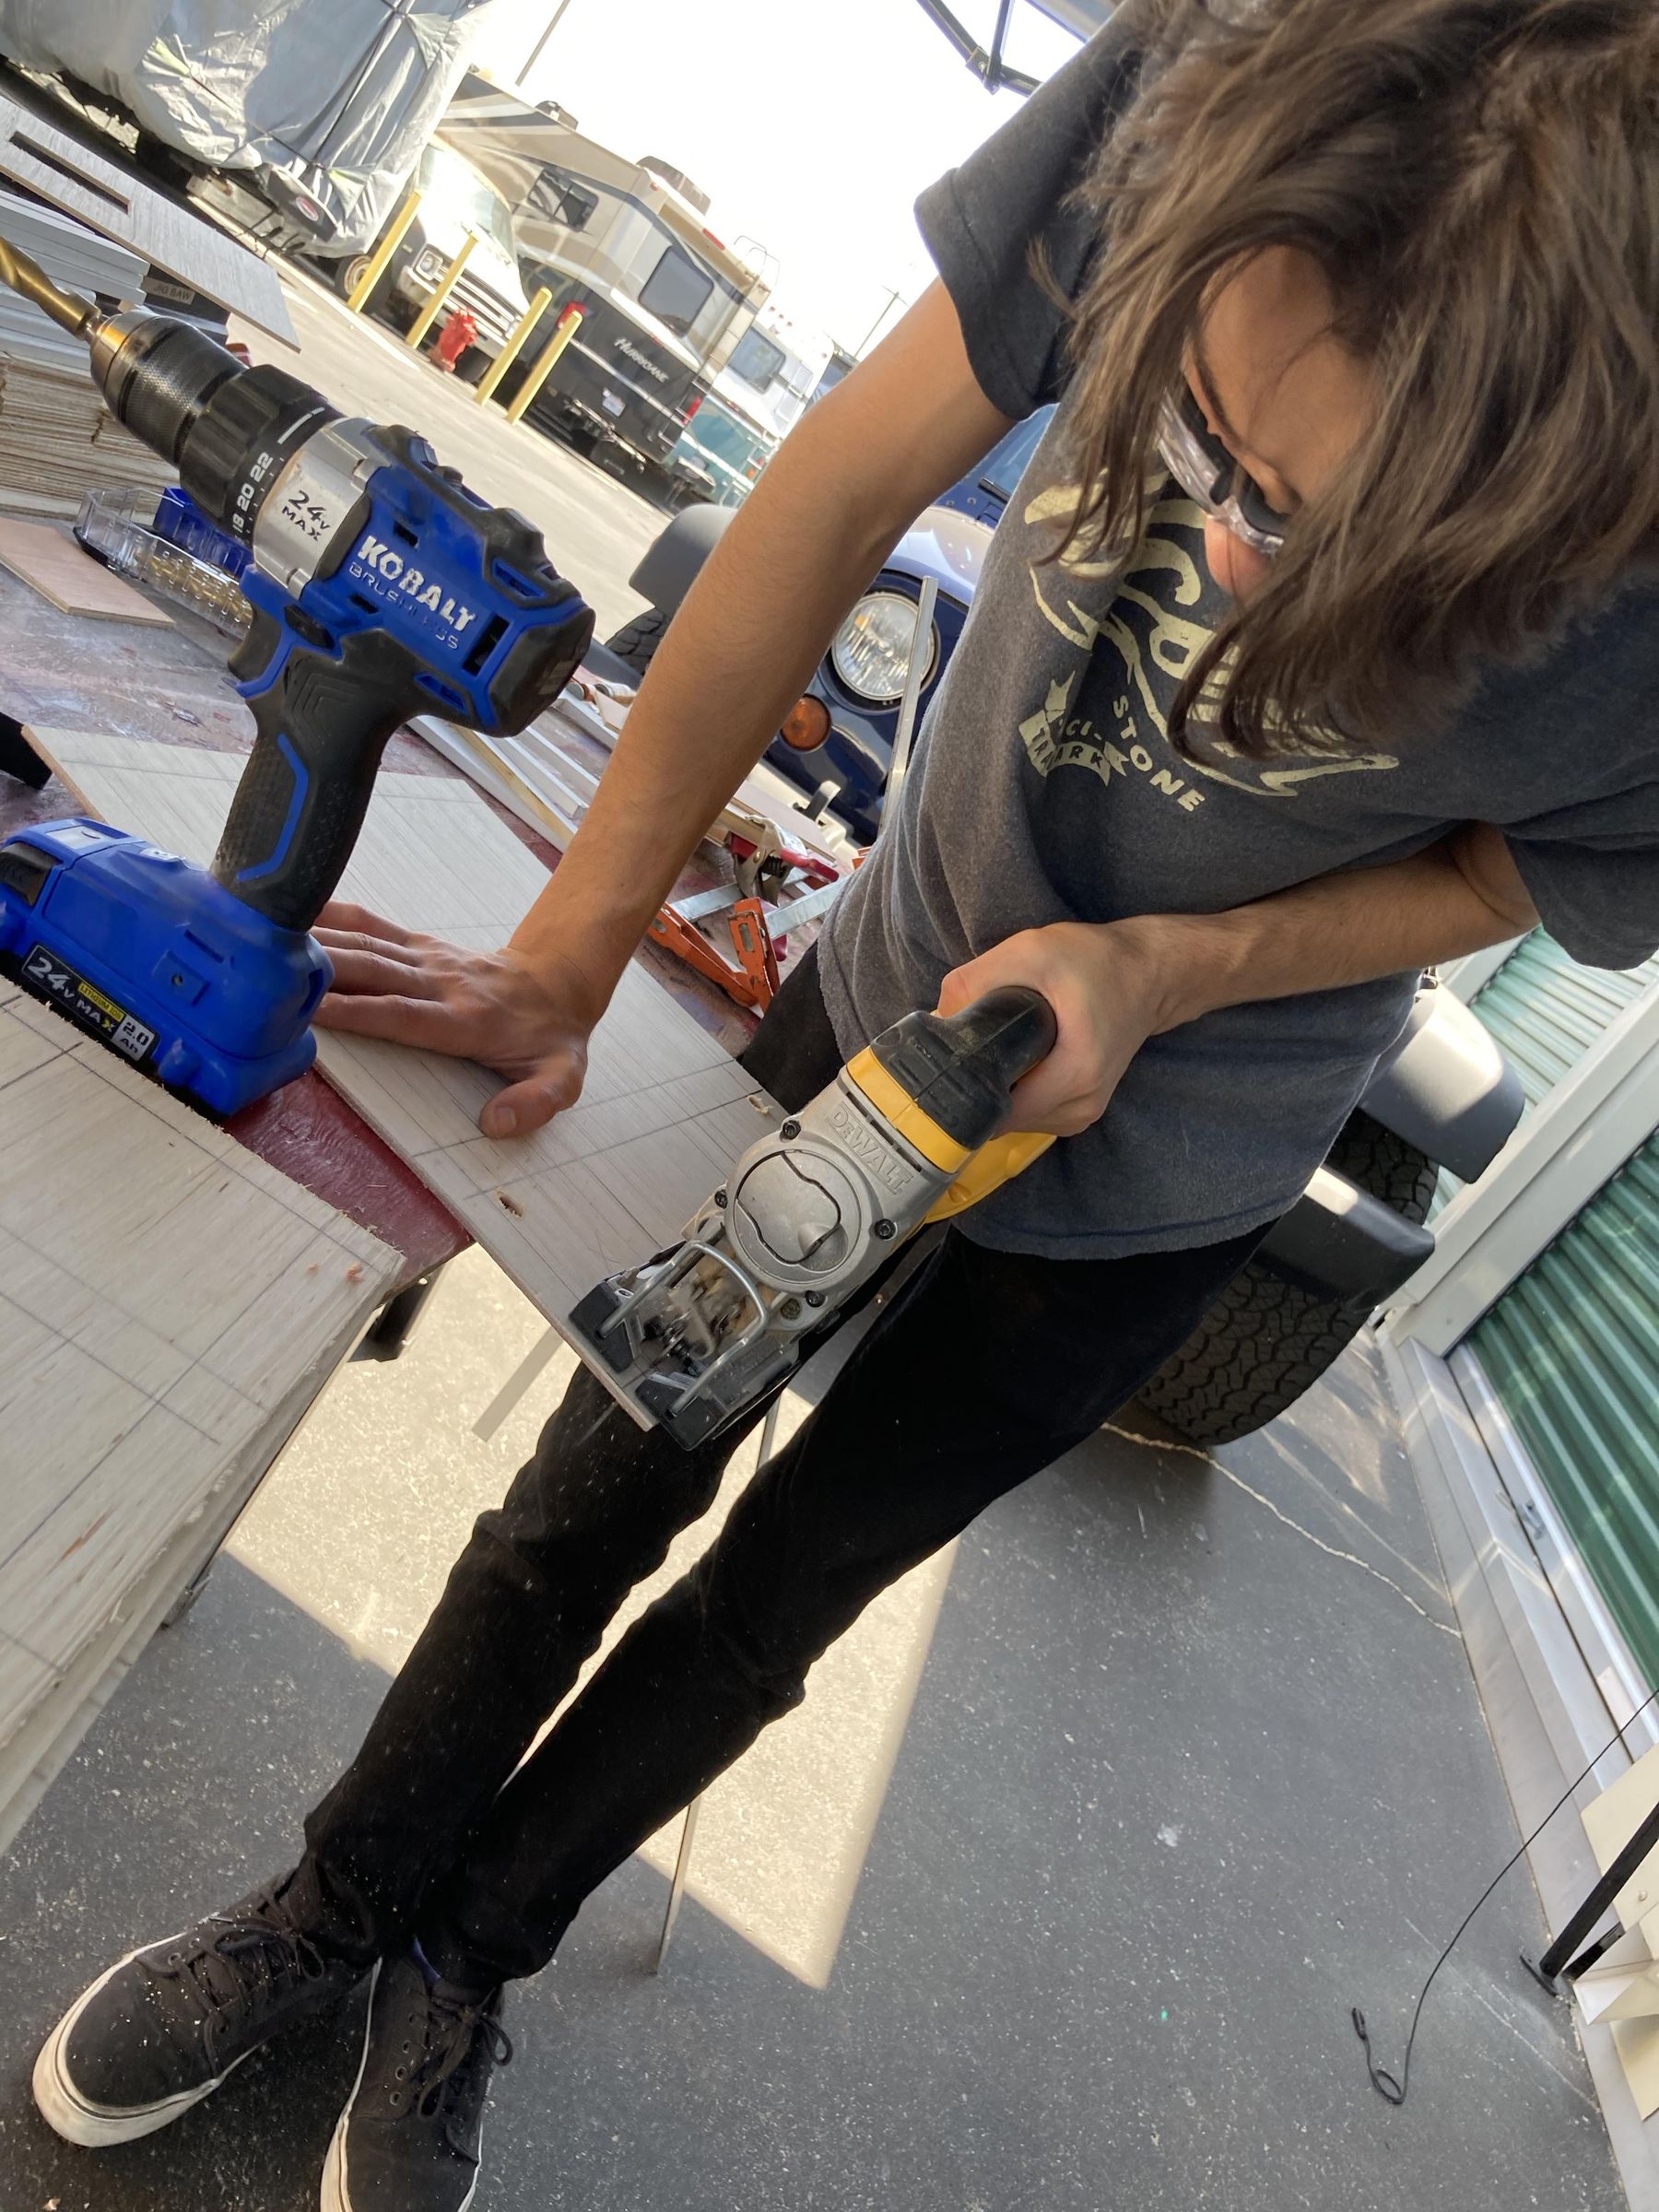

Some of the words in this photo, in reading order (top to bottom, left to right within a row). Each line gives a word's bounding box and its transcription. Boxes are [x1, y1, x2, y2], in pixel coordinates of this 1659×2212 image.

[250, 452, 274, 483] 22
[237, 483, 255, 512] 20
[232, 513, 245, 534] 18
[281, 506, 322, 542] MAX
[358, 535, 477, 631] KOBALT
[1112, 695, 1206, 812] STONE
[76, 999, 116, 1033] MAX
[120, 1038, 138, 1053] Ah
[123, 1021, 149, 1046] 2.0
